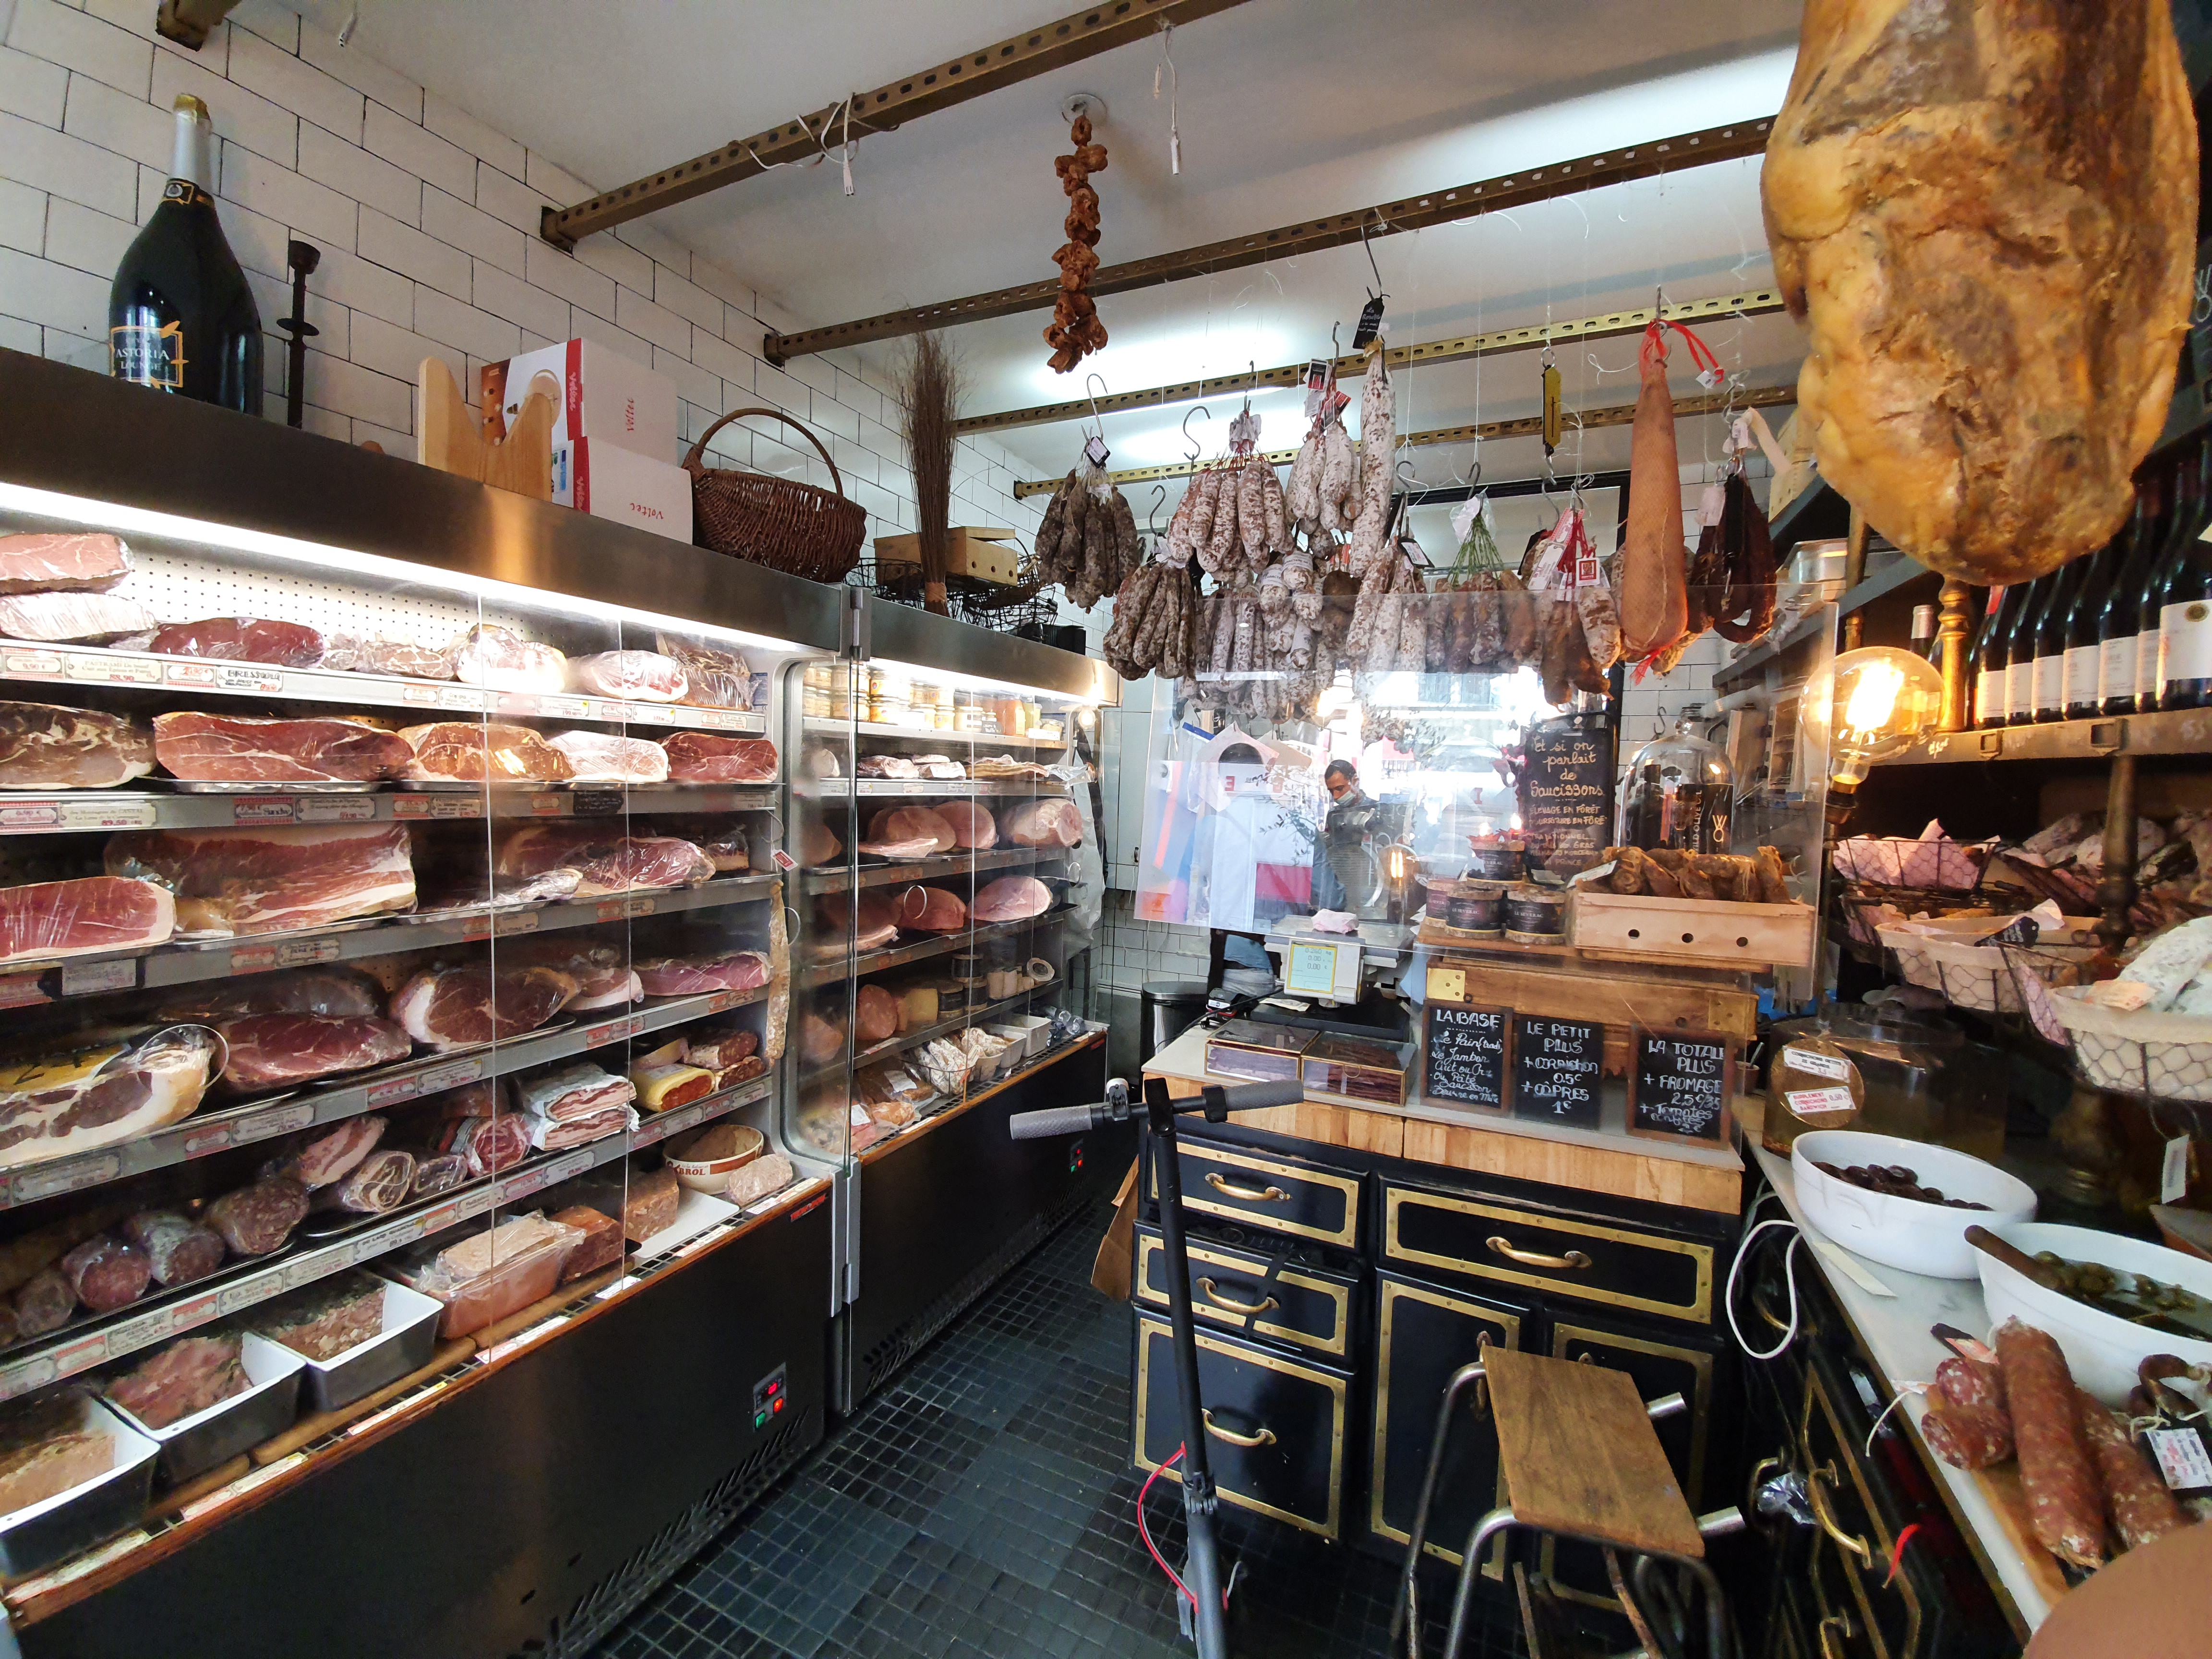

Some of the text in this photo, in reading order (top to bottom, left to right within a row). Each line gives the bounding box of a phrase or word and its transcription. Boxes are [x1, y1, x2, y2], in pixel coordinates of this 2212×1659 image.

[625, 397, 634, 432] Voltec
[629, 502, 664, 520] Voltec
[1550, 740, 1566, 751] si
[1574, 742, 1595, 751] on
[1542, 751, 1597, 773] parlait
[1560, 768, 1577, 781] de
[1530, 780, 1603, 797] Saucissons
[1527, 1021, 1591, 1038] LE PETIT
[1544, 1038, 1583, 1054] PLUS
[1648, 1040, 1667, 1054] LA
[1677, 1057, 1716, 1074] PLUS
[1659, 1074, 1723, 1094] FROMAGE
